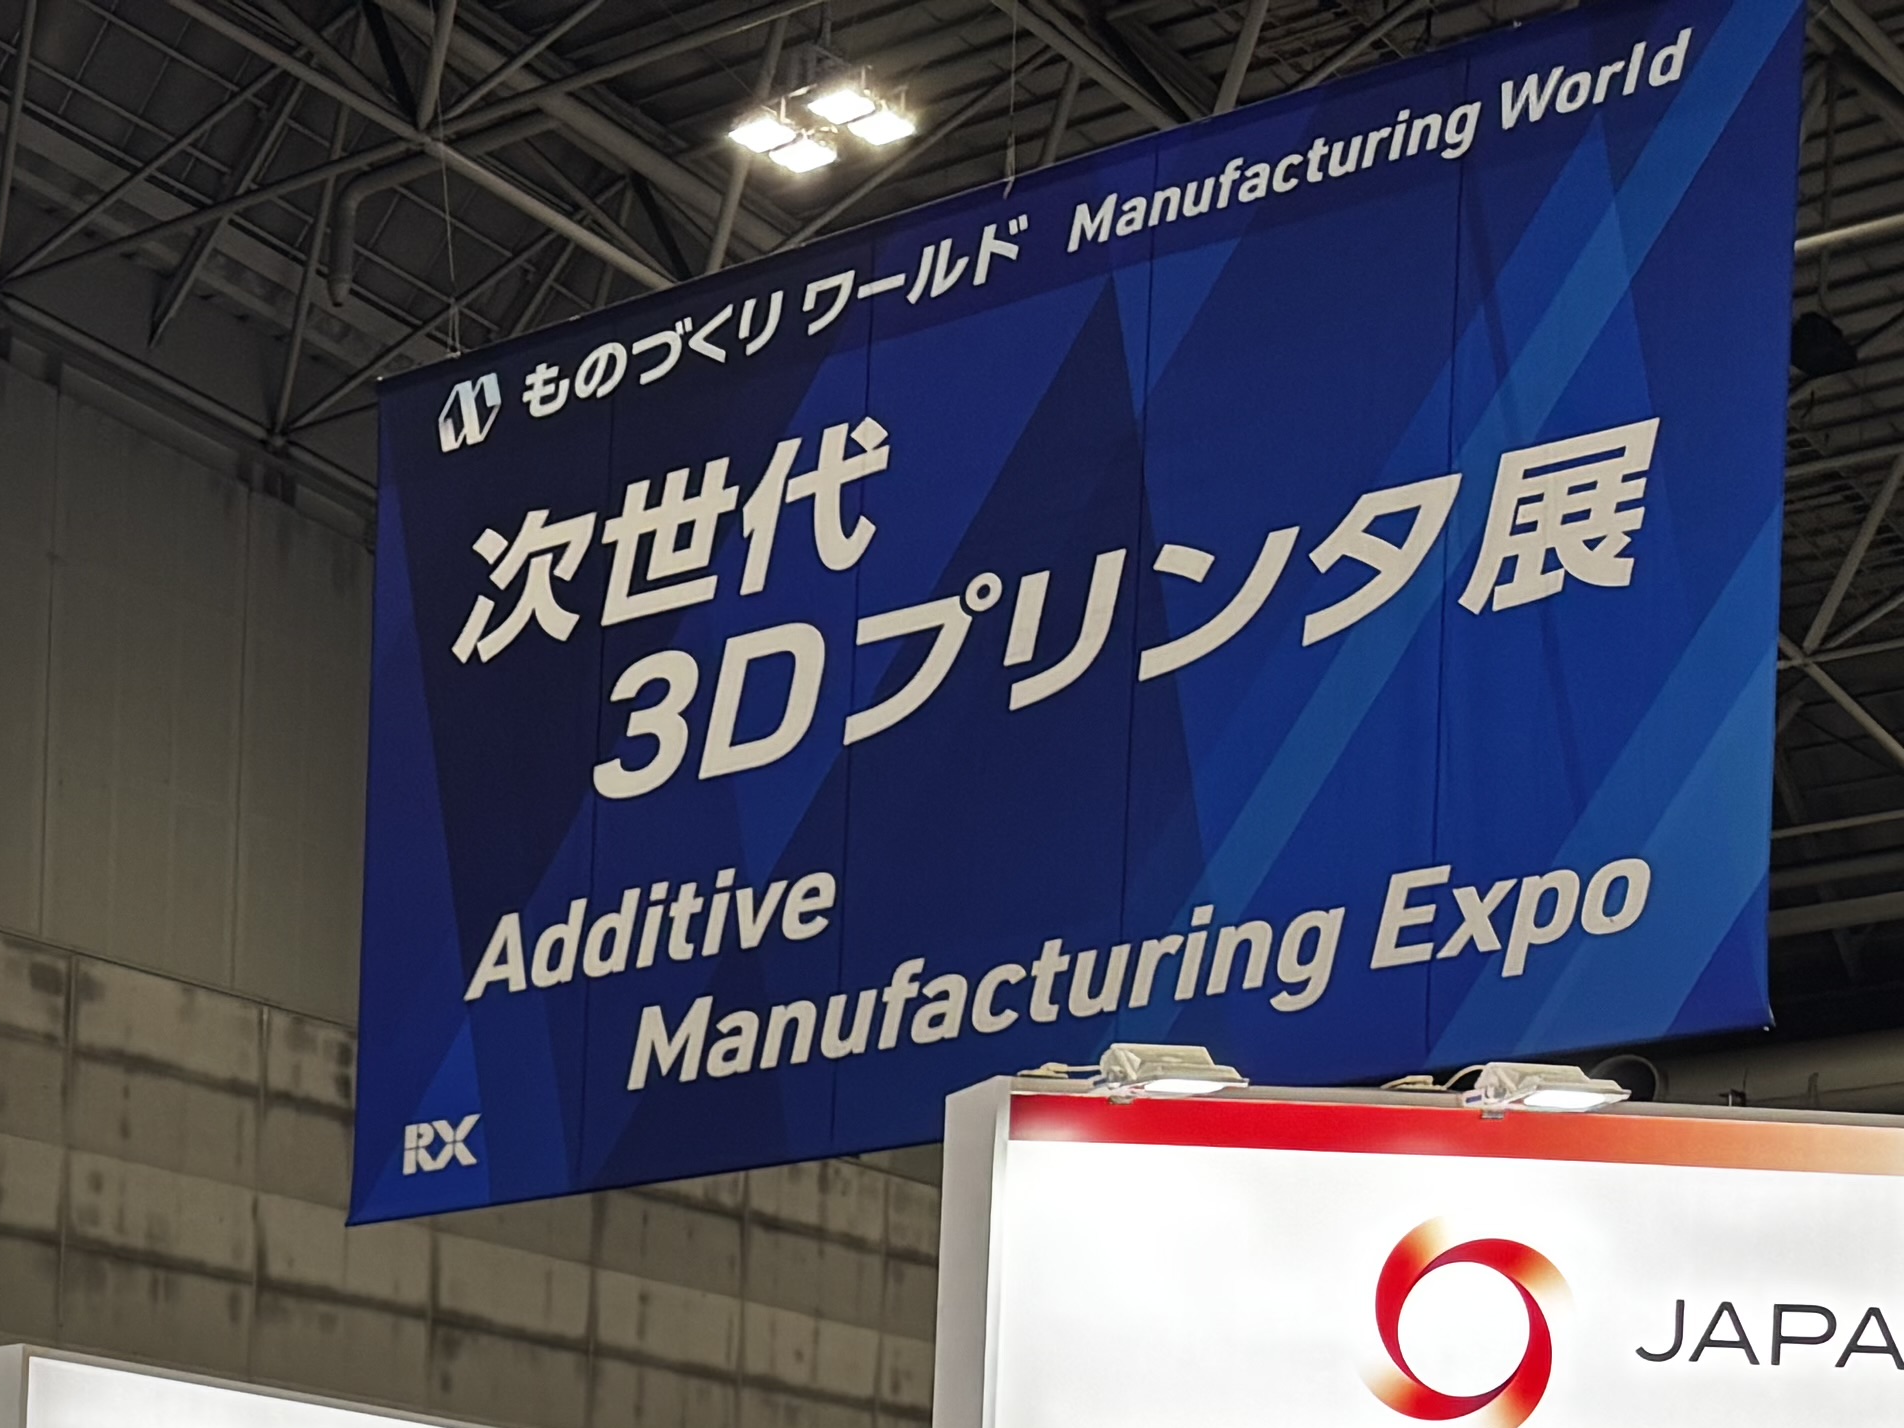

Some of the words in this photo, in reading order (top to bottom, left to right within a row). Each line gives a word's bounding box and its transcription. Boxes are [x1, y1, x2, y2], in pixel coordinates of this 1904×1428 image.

[521, 288, 781, 418] ものづくり
[801, 214, 1029, 335] ワールド
[1067, 103, 1480, 253] Manufacturing
[1497, 30, 1692, 133] World
[452, 416, 890, 666] 次世代
[592, 416, 1661, 801] 3Dプリンタ展
[465, 867, 837, 1001] Additive
[627, 894, 1345, 1091] Manufacturing
[1369, 856, 1650, 980] Expo
[402, 1113, 480, 1177] RX
